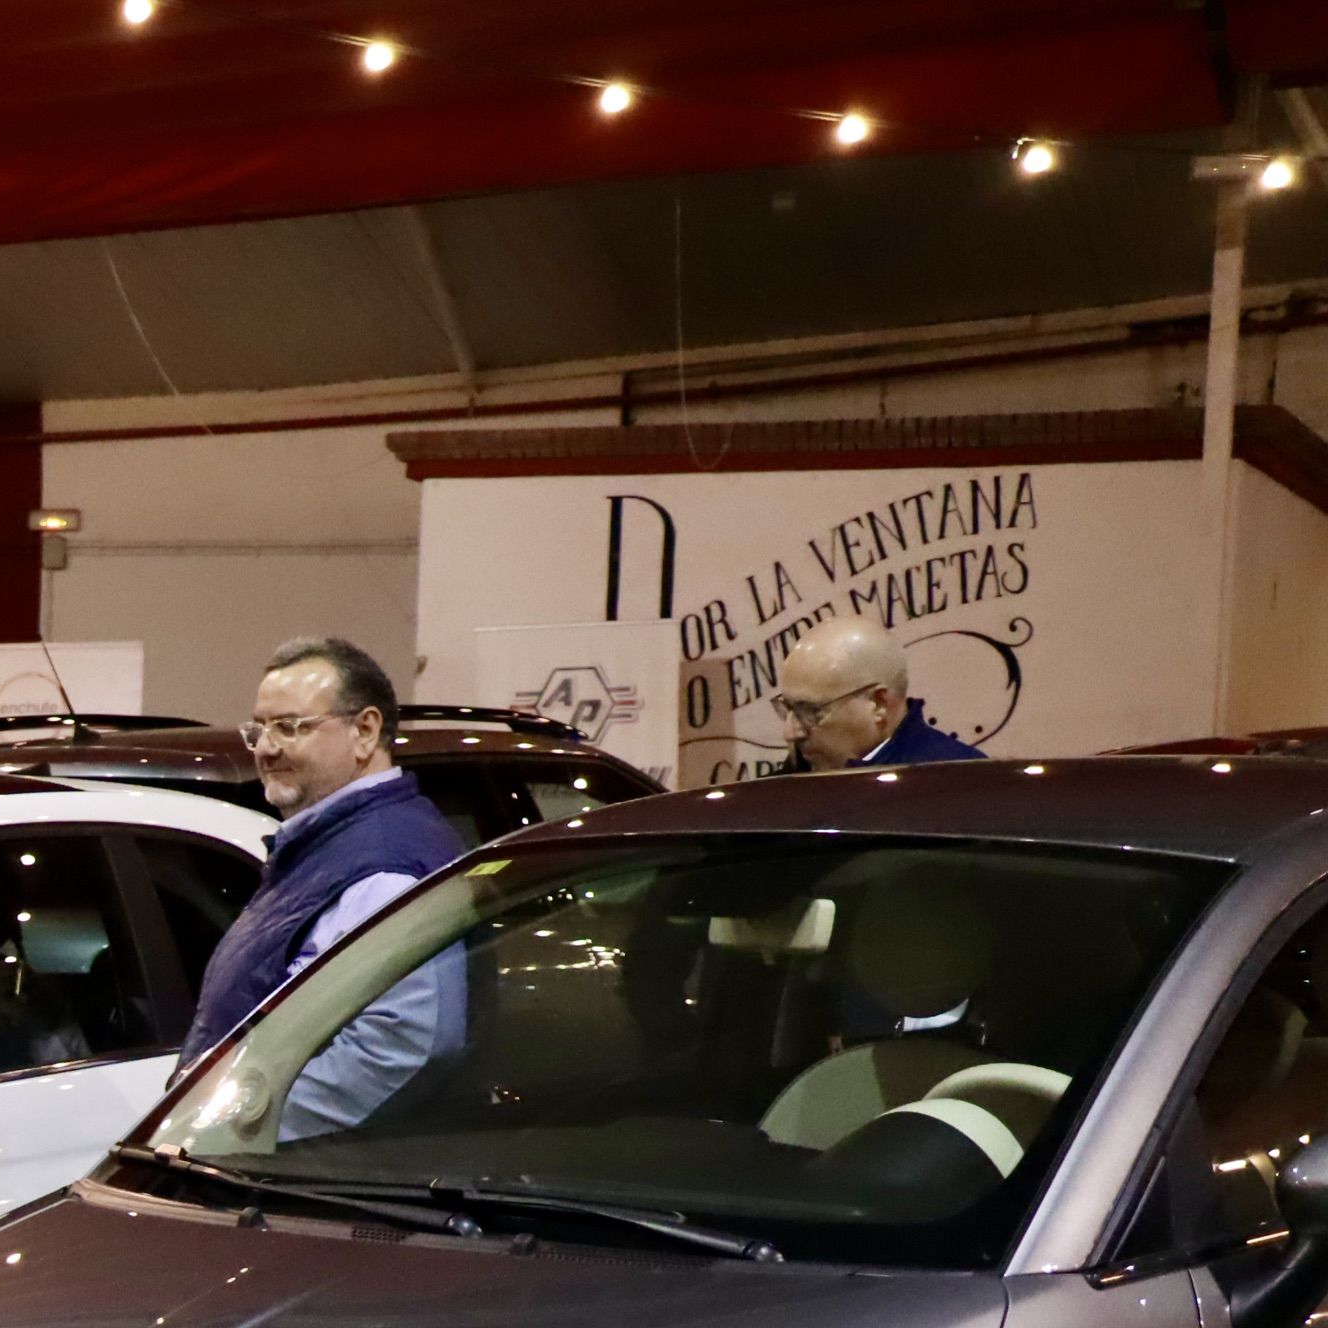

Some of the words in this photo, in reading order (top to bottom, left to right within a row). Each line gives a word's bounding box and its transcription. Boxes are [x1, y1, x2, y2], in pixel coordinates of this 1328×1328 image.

[746, 560, 803, 626] LA
[808, 472, 1038, 584] VENTANA
[687, 674, 711, 729] O
[849, 542, 1030, 630] MACETAS
